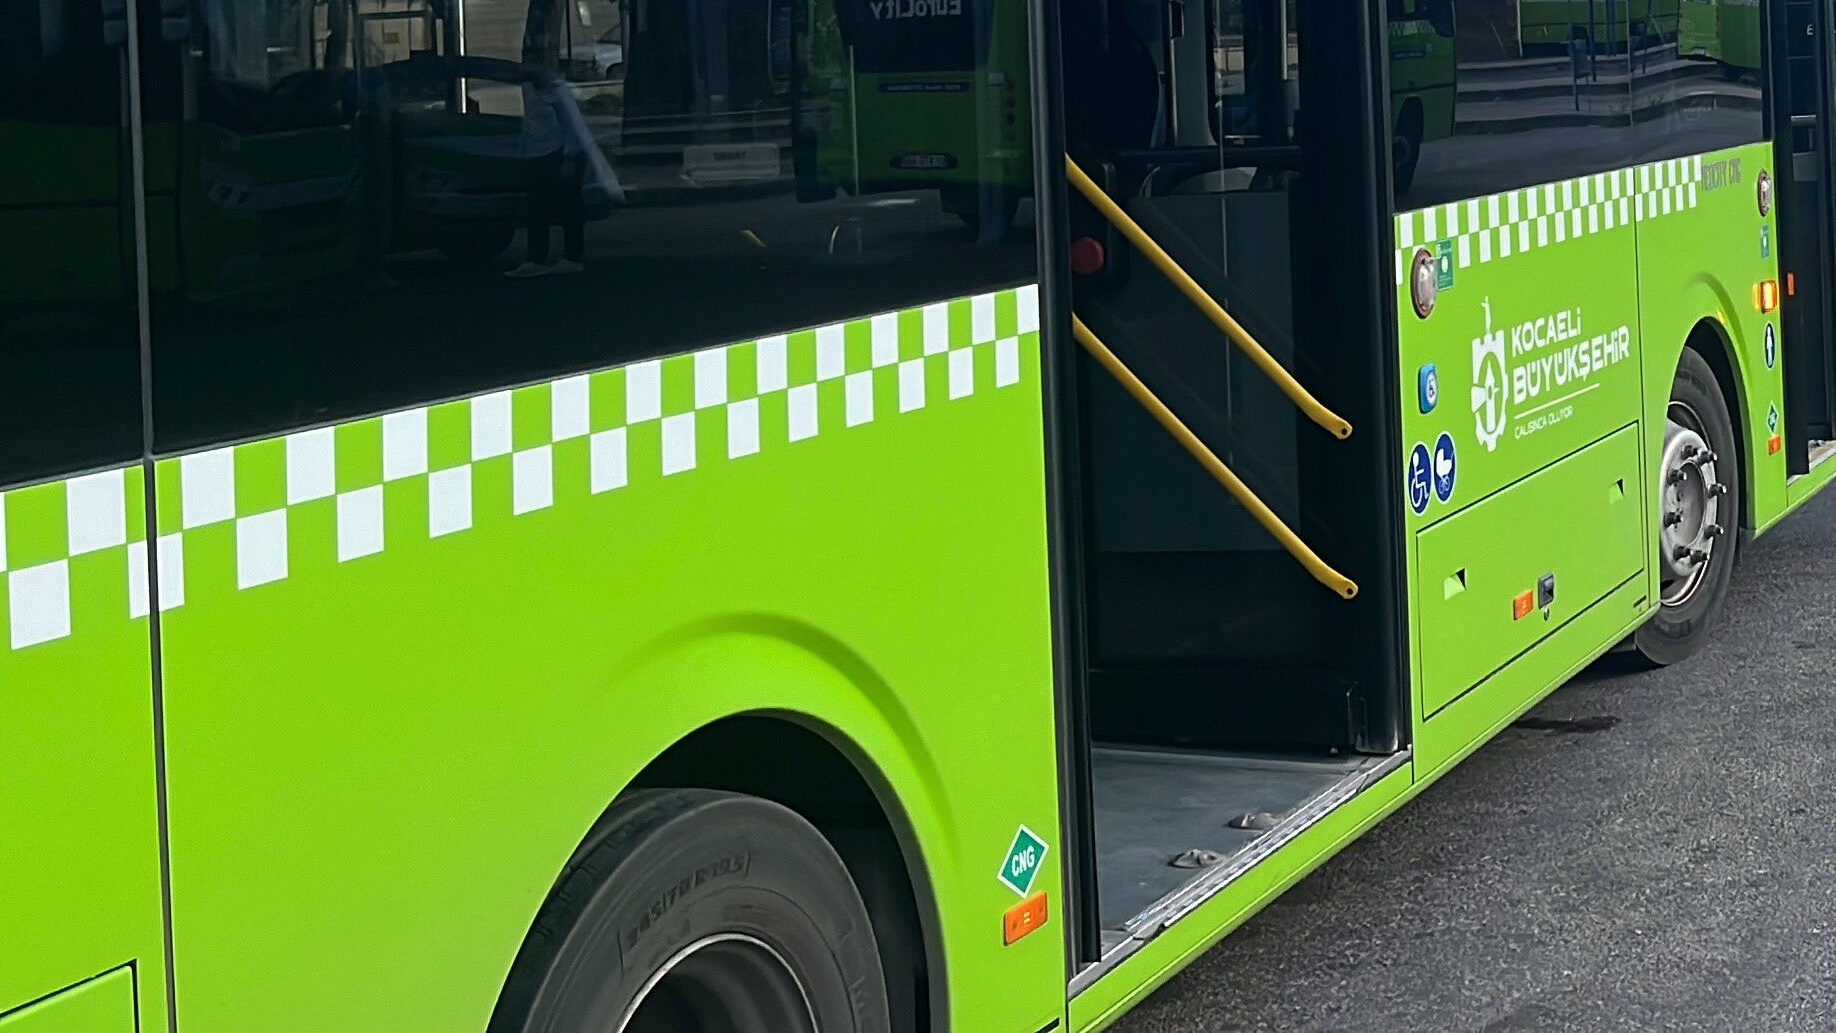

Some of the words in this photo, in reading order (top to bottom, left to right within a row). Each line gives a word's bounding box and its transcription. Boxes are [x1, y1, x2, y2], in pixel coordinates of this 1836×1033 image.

[1511, 306, 1582, 358] KOCAELİ
[1512, 325, 1630, 405] BÜYÜKŞEHİR
[1011, 845, 1036, 878] CNG
